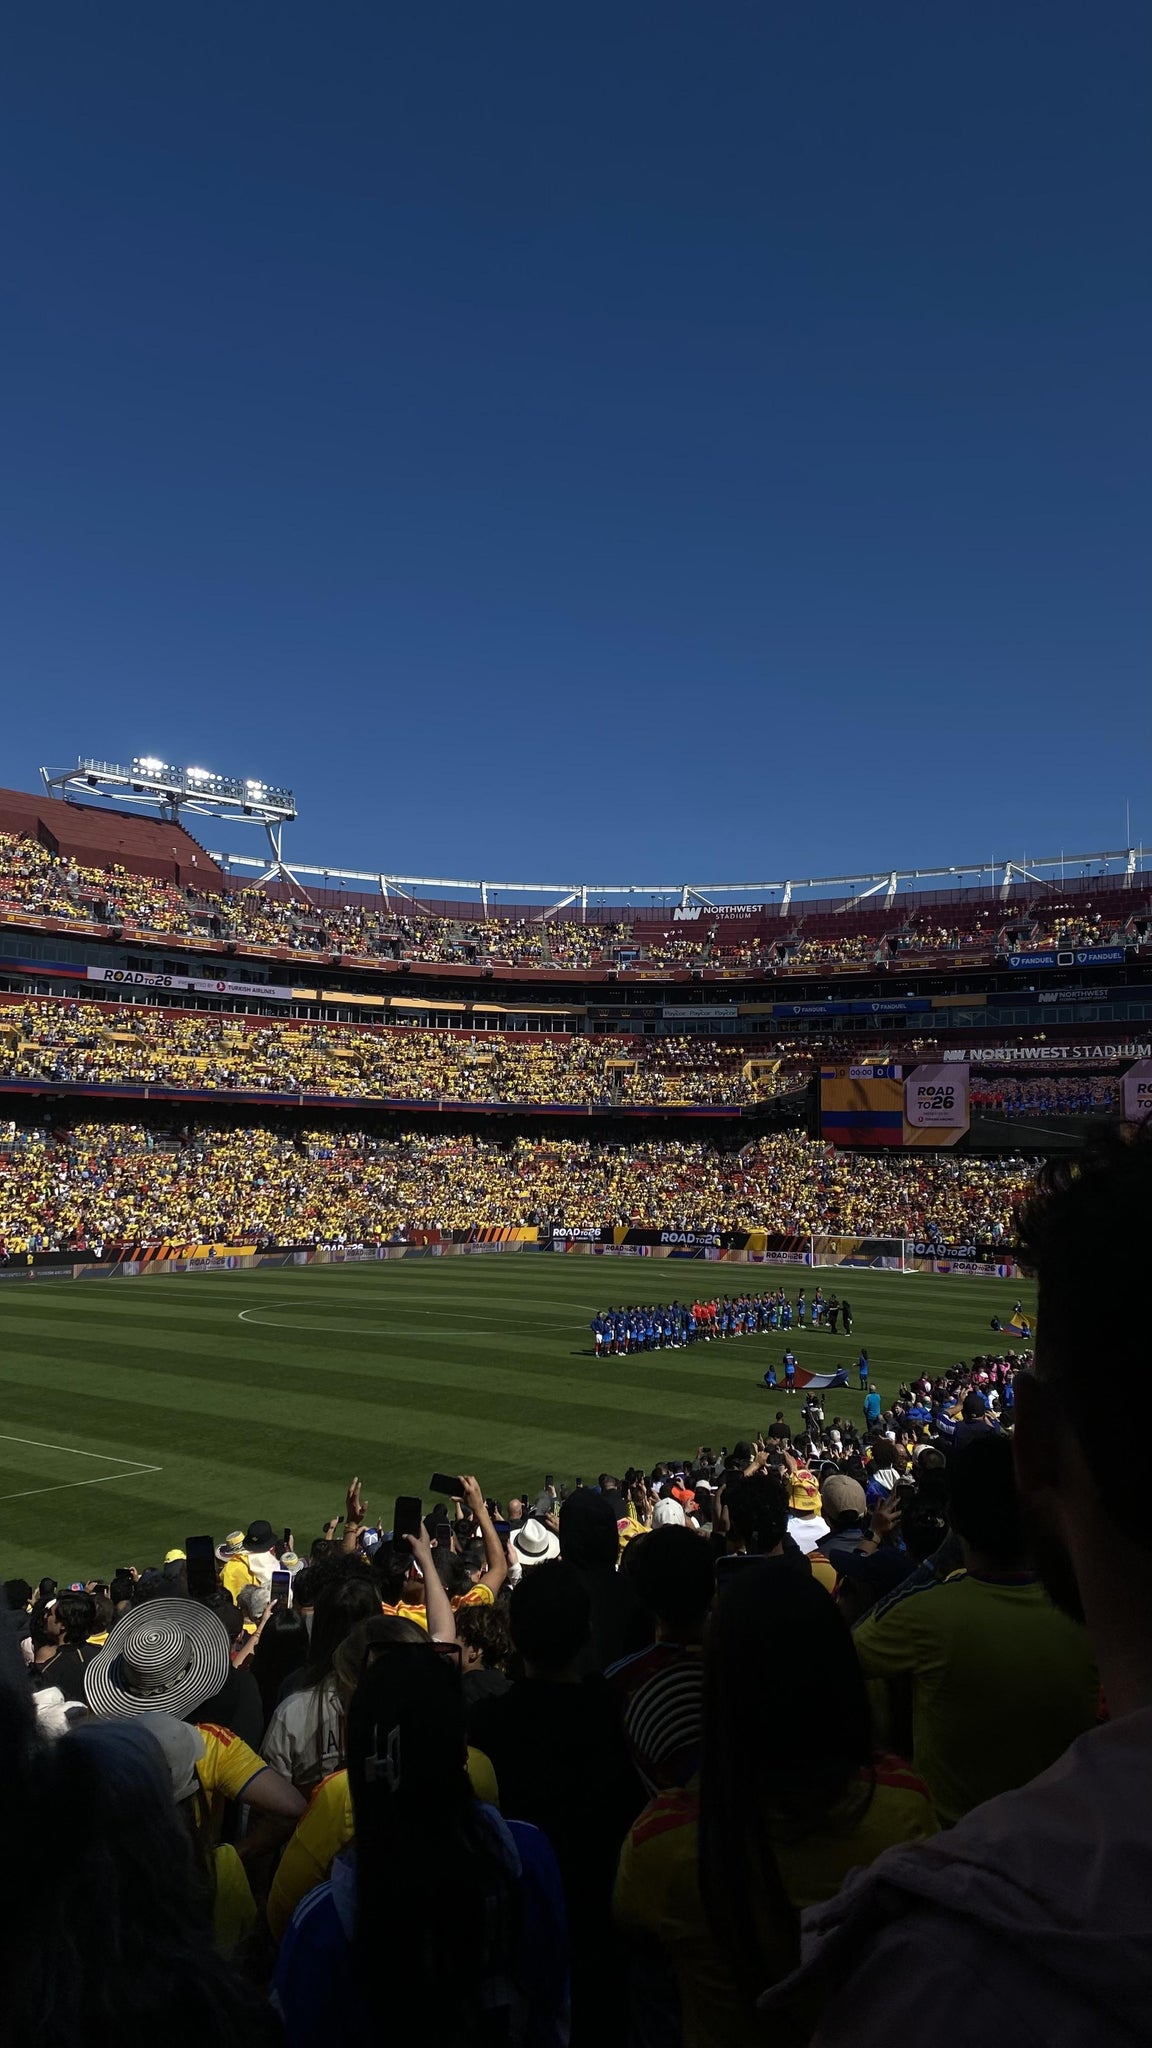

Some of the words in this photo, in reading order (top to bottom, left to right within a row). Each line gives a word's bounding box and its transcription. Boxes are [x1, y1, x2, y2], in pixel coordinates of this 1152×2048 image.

[703, 905, 763, 914] NORTHWEST
[1021, 957, 1054, 965] FANDUEL
[1088, 952, 1122, 961] FANDUEL
[104, 970, 144, 984] ROAD
[155, 975, 173, 987] 26
[228, 985, 252, 993] TURKISH
[252, 987, 276, 995] AIRLINES
[1058, 990, 1109, 998] NORTHWEST
[969, 1047, 1070, 1061] NORTHWEST
[1072, 1044, 1152, 1058] STADIUM
[878, 1067, 885, 1076] 0
[917, 1086, 955, 1096] ROAD
[552, 1228, 581, 1237] ROAD
[660, 1232, 696, 1243] ROAD
[905, 1243, 947, 1257] ROAD
[189, 1258, 211, 1267] ROAD
[952, 1262, 978, 1271] ROAD
[984, 1264, 996, 1272] 26
